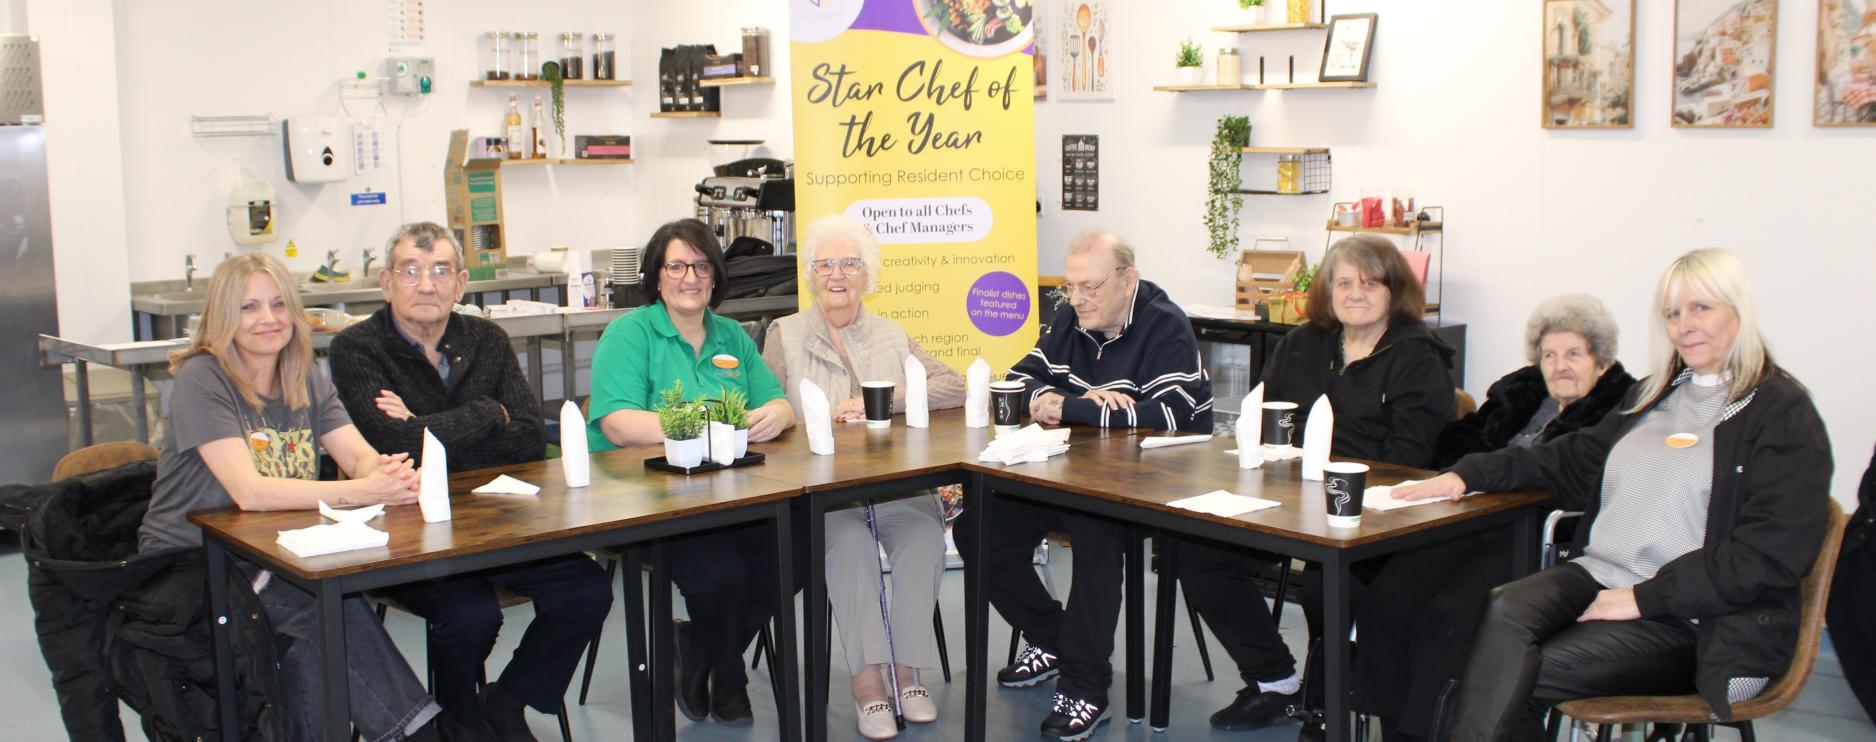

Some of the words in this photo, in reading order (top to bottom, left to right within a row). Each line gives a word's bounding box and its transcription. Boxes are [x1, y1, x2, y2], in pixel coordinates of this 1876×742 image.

[807, 62, 884, 108] Star
[896, 59, 980, 111] Chef
[988, 65, 1018, 111] of
[839, 110, 897, 158] the
[907, 110, 983, 155] Year
[806, 170, 892, 187] Supporting
[897, 168, 964, 183] Resident
[969, 167, 1025, 181] Choice
[862, 206, 897, 222] Open
[899, 206, 913, 217] to
[915, 204, 932, 216] all
[935, 203, 973, 216] Chefs
[876, 220, 908, 234] Chef
[909, 221, 974, 236] Managers
[883, 256, 937, 269] creativity
[941, 256, 950, 265] &
[952, 253, 1016, 265] innovation
[876, 282, 892, 294] ed
[895, 281, 940, 295] judging
[972, 287, 1000, 298] Finalist
[1001, 290, 1027, 300] dishes
[980, 298, 1018, 309] featured
[890, 308, 930, 320] action
[970, 309, 983, 317] on
[984, 308, 999, 319] the
[1000, 311, 1025, 320] menu
[913, 333, 929, 344] ch
[931, 332, 969, 346] region
[926, 346, 953, 358] rand
[956, 345, 982, 357] final
